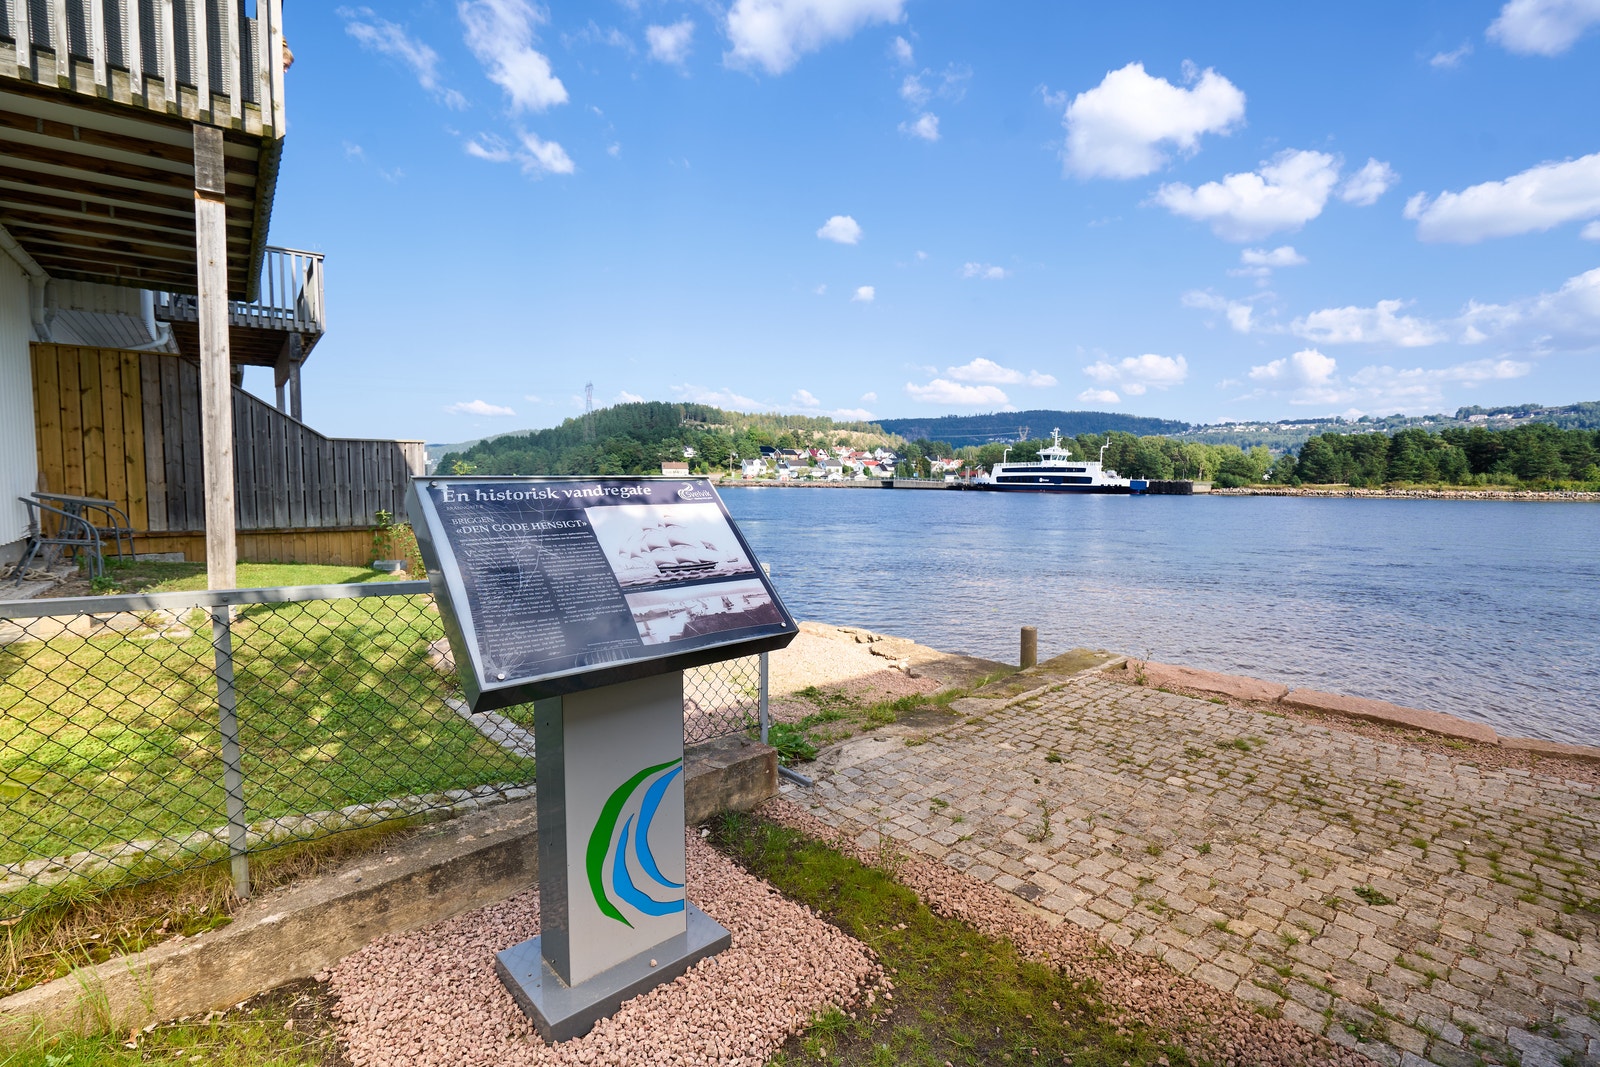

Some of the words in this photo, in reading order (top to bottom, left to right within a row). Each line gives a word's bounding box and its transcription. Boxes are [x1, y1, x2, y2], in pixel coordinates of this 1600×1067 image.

[442, 489, 470, 503] En
[475, 487, 560, 502] historisk
[562, 485, 651, 499] vandregate
[451, 516, 495, 525] BRIGGEN
[492, 522, 530, 532] GODE
[531, 519, 587, 530] HENSIGT»
